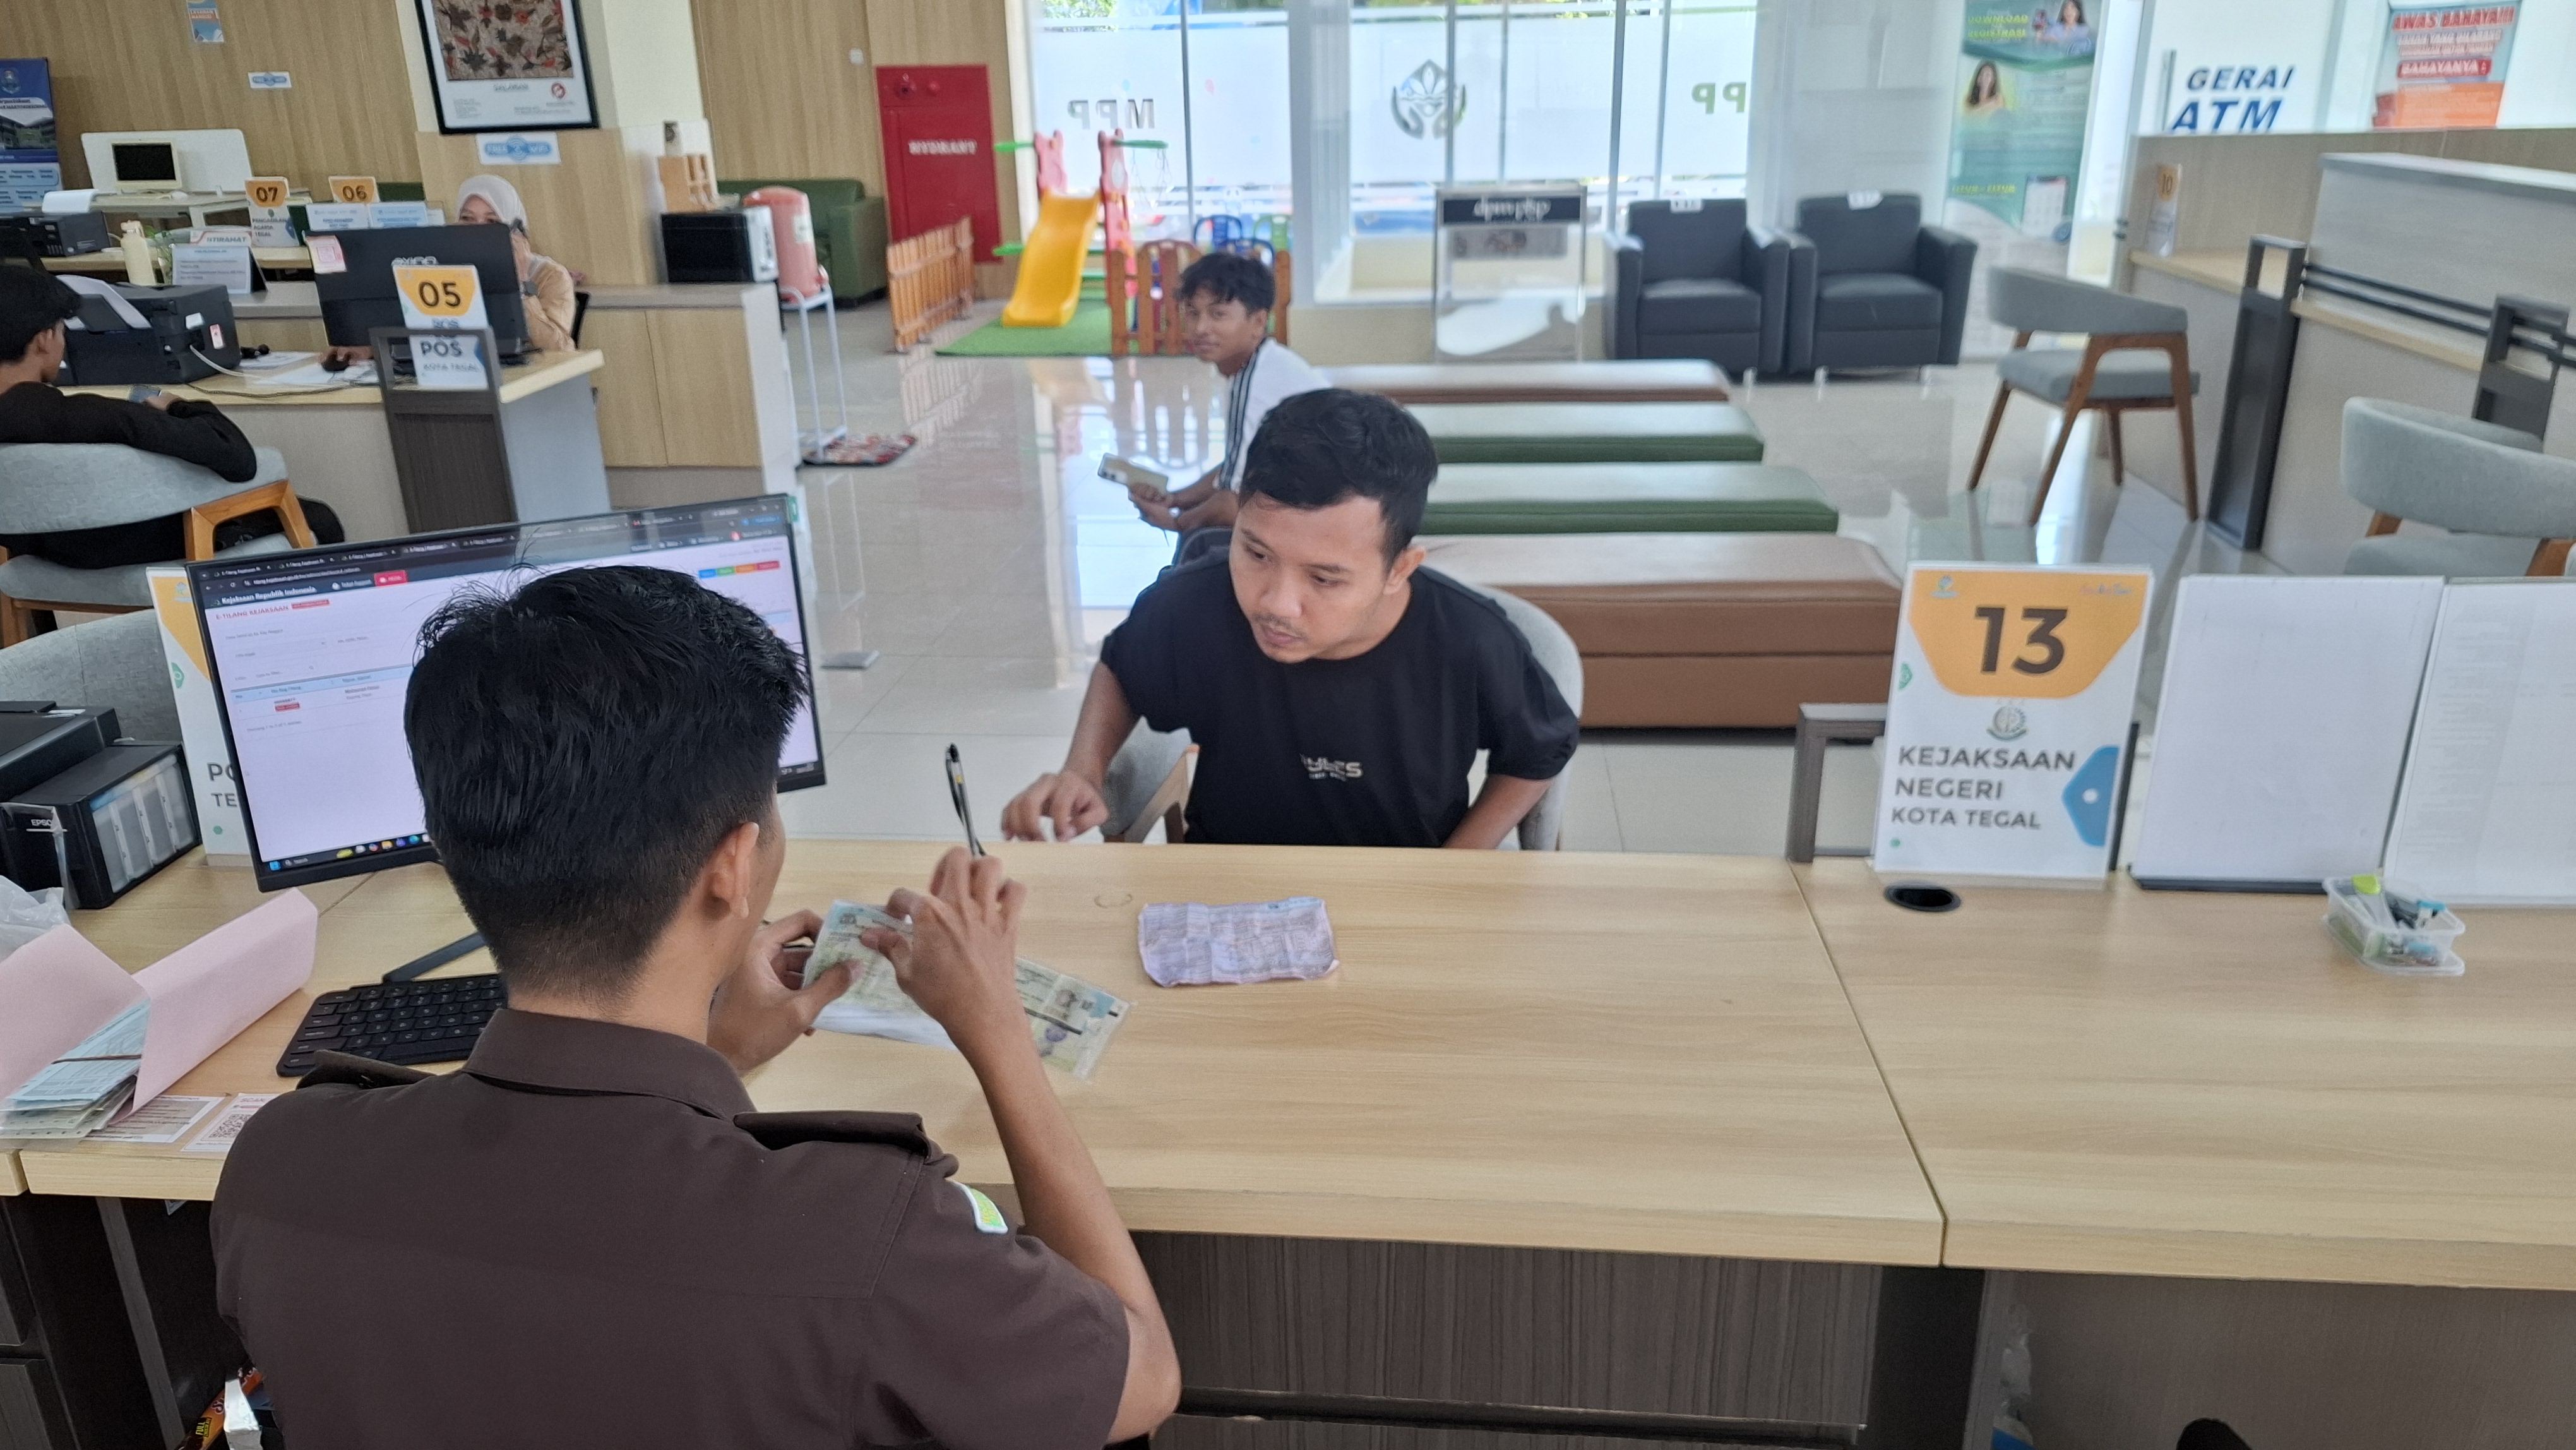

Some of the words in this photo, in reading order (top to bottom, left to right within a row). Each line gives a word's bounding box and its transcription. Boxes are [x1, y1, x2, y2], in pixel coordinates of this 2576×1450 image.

[2188, 68, 2294, 90] GERAI
[2172, 101, 2283, 132] ATM
[256, 186, 278, 202] 07
[342, 185, 367, 201] 06
[2161, 174, 2173, 195] 10
[418, 280, 462, 308] 05
[420, 340, 463, 357] POS
[222, 594, 254, 604] Kejaksaan
[255, 590, 283, 601] Republik
[284, 585, 317, 596] Indonesia
[215, 610, 247, 620] E-TILANG
[249, 605, 289, 615] KEJAKSAAN
[1974, 607, 2068, 674] 13
[1898, 746, 2076, 770] KEJAKSAAN
[1895, 778, 2003, 801] NEGERI
[1891, 807, 1957, 827] KOTA
[1965, 810, 2041, 830] TEGAL
